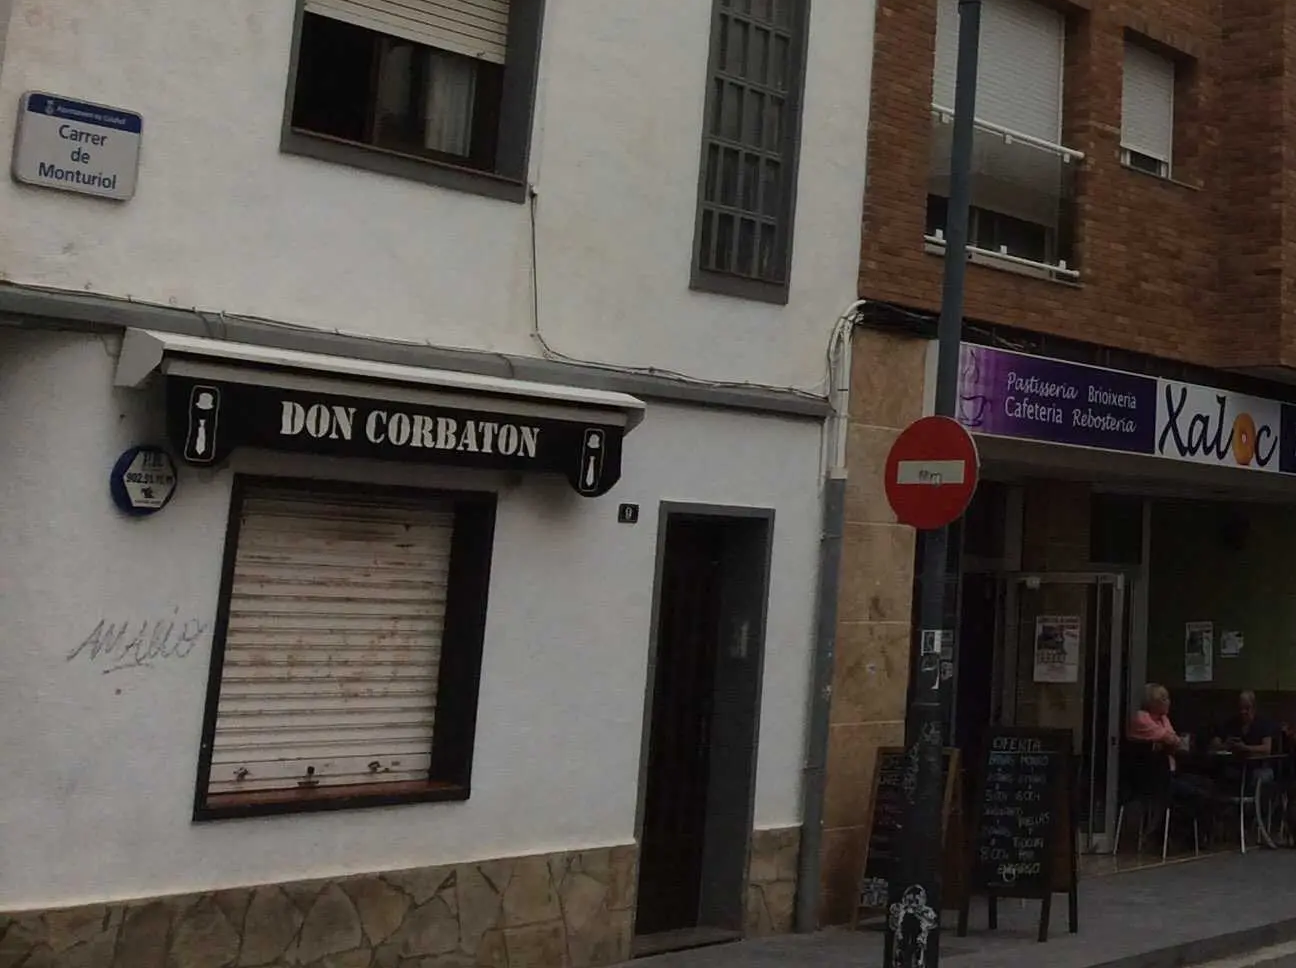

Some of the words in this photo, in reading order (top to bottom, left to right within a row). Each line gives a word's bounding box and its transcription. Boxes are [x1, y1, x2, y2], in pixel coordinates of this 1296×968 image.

[59, 124, 107, 146] Carrer
[70, 147, 90, 164] de
[38, 162, 117, 189] Monturiol
[1007, 371, 1079, 400] Pastisseria
[1004, 396, 1063, 424] Cafeteria
[1072, 408, 1136, 433] Rebosteria
[1158, 383, 1278, 469] Xaloc
[280, 401, 357, 441] DON
[365, 409, 540, 458] CORBATON
